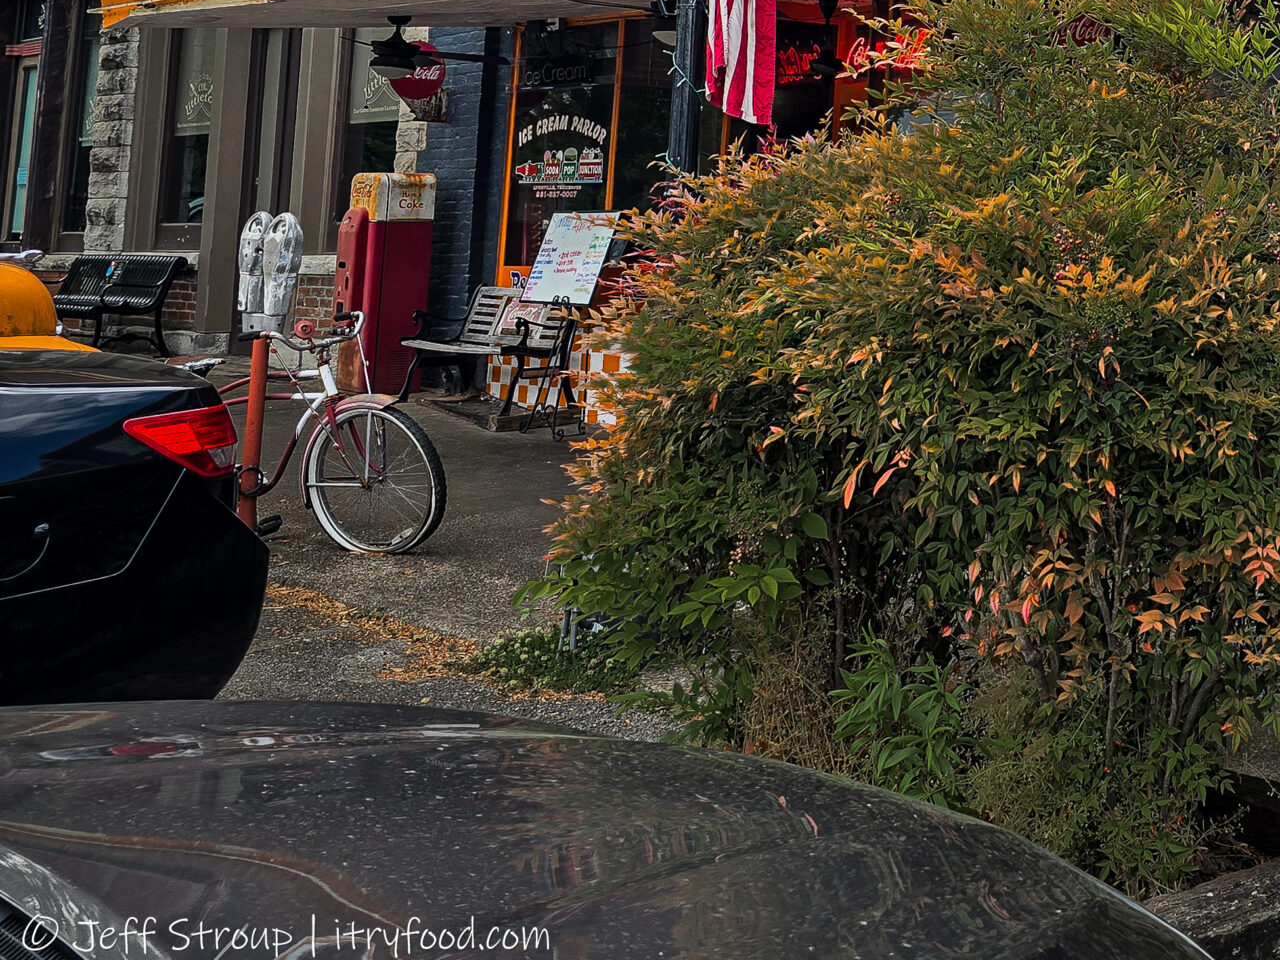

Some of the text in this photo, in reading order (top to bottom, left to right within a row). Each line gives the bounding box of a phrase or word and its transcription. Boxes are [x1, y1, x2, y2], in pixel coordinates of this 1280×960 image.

[519, 115, 607, 147] ICE CREAM PARLOR
[545, 165, 602, 175] SODA POP JUNCTION
[399, 199, 424, 209] Coke
